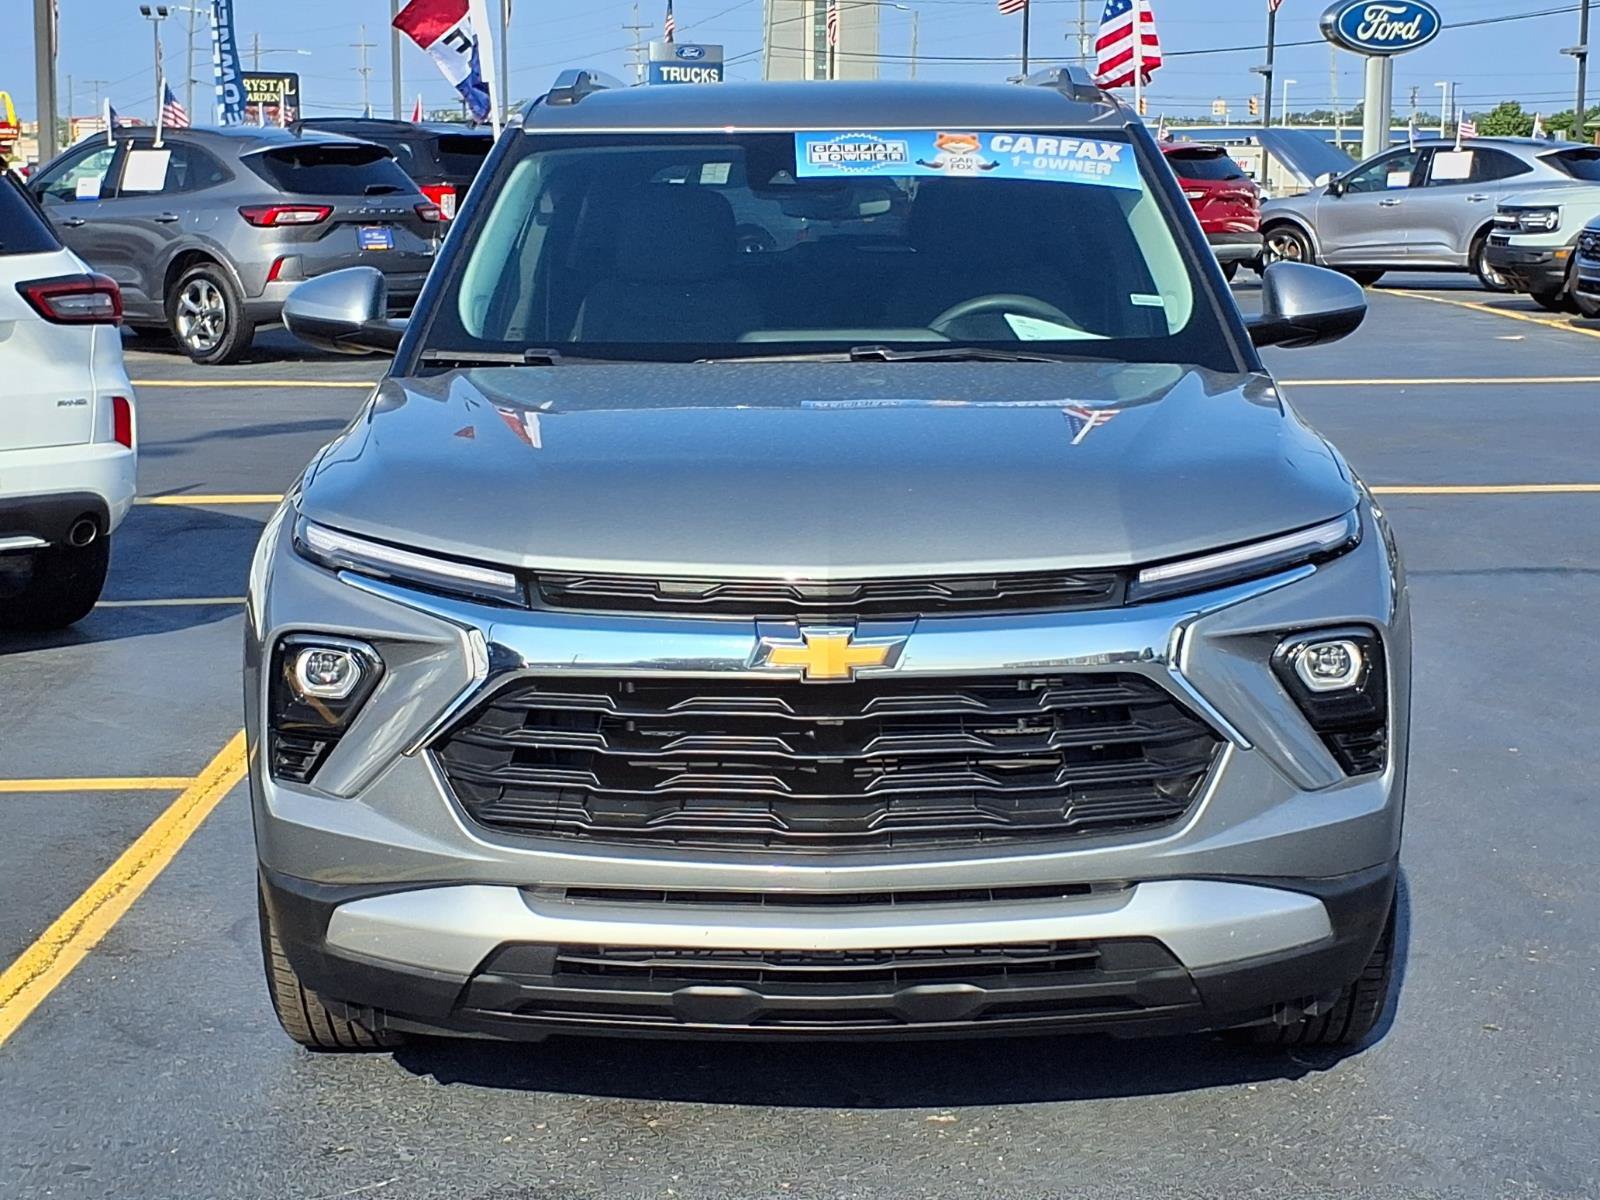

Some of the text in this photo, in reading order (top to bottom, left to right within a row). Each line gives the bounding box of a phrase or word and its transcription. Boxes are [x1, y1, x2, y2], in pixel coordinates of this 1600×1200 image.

[1357, 4, 1423, 41] Ford
[660, 66, 719, 84] TRUCKS
[242, 78, 296, 95] RYSTAL
[246, 92, 281, 102] ARDEN
[813, 144, 903, 152] CARFAX
[990, 135, 1123, 162] CARFAX
[829, 153, 903, 161] OWNER
[1011, 154, 1113, 175] 1-OWNER
